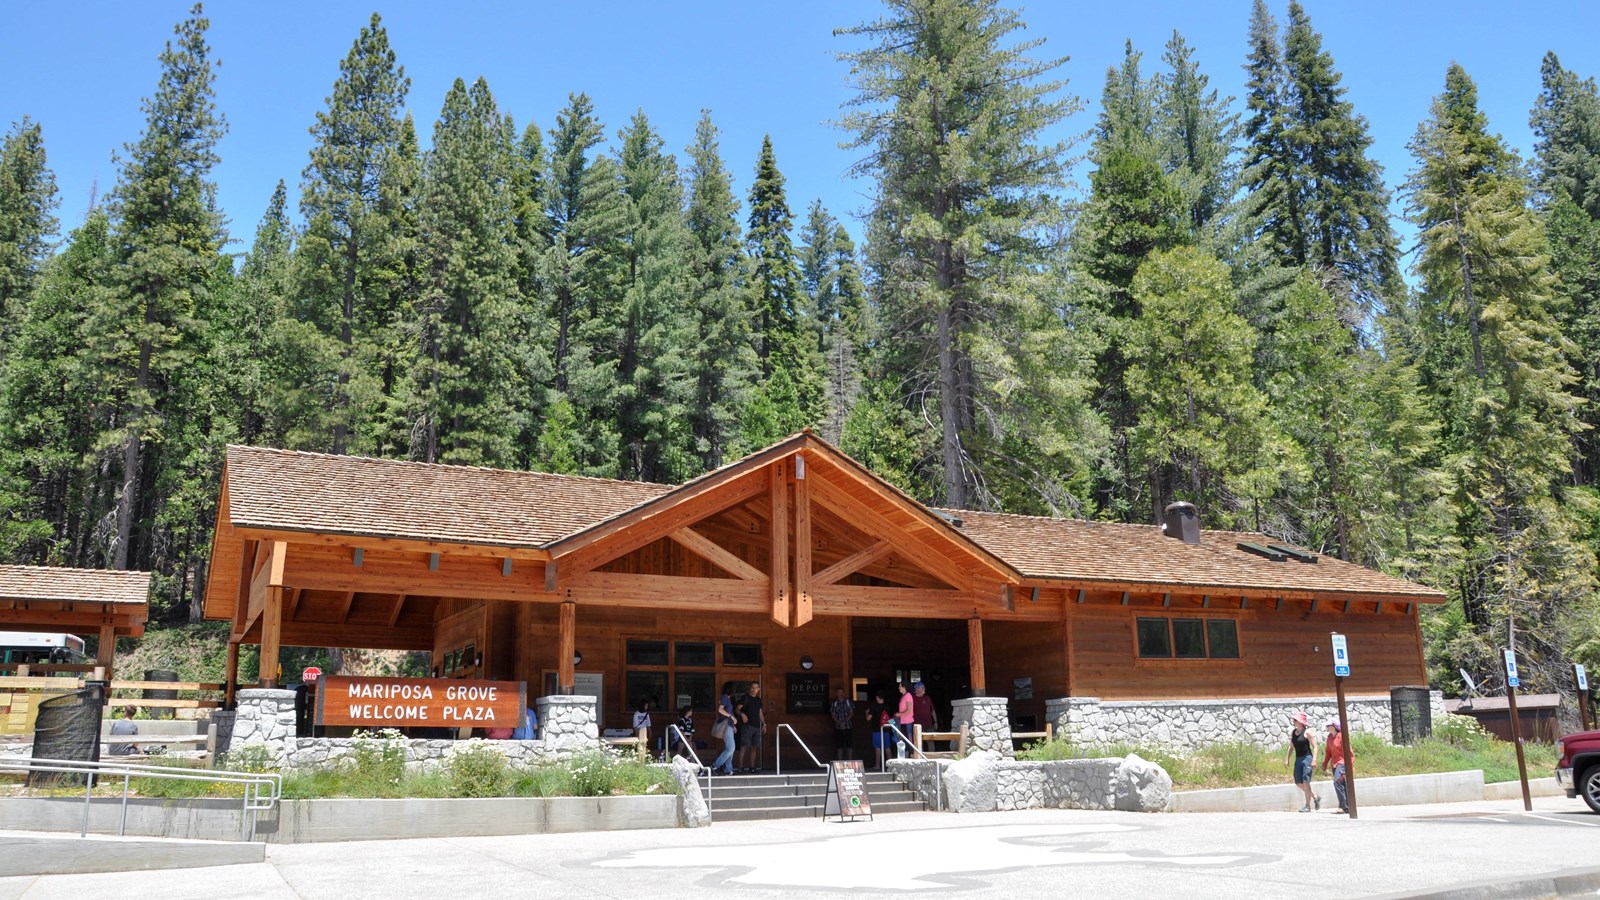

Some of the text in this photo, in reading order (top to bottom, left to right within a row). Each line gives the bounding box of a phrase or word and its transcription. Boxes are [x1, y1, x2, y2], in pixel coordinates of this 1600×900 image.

[304, 672, 320, 680] STO
[348, 683, 497, 701] MARIPOSA GROVE
[791, 684, 826, 692] DEPOT
[350, 704, 495, 721] WELCOME PLAZA
